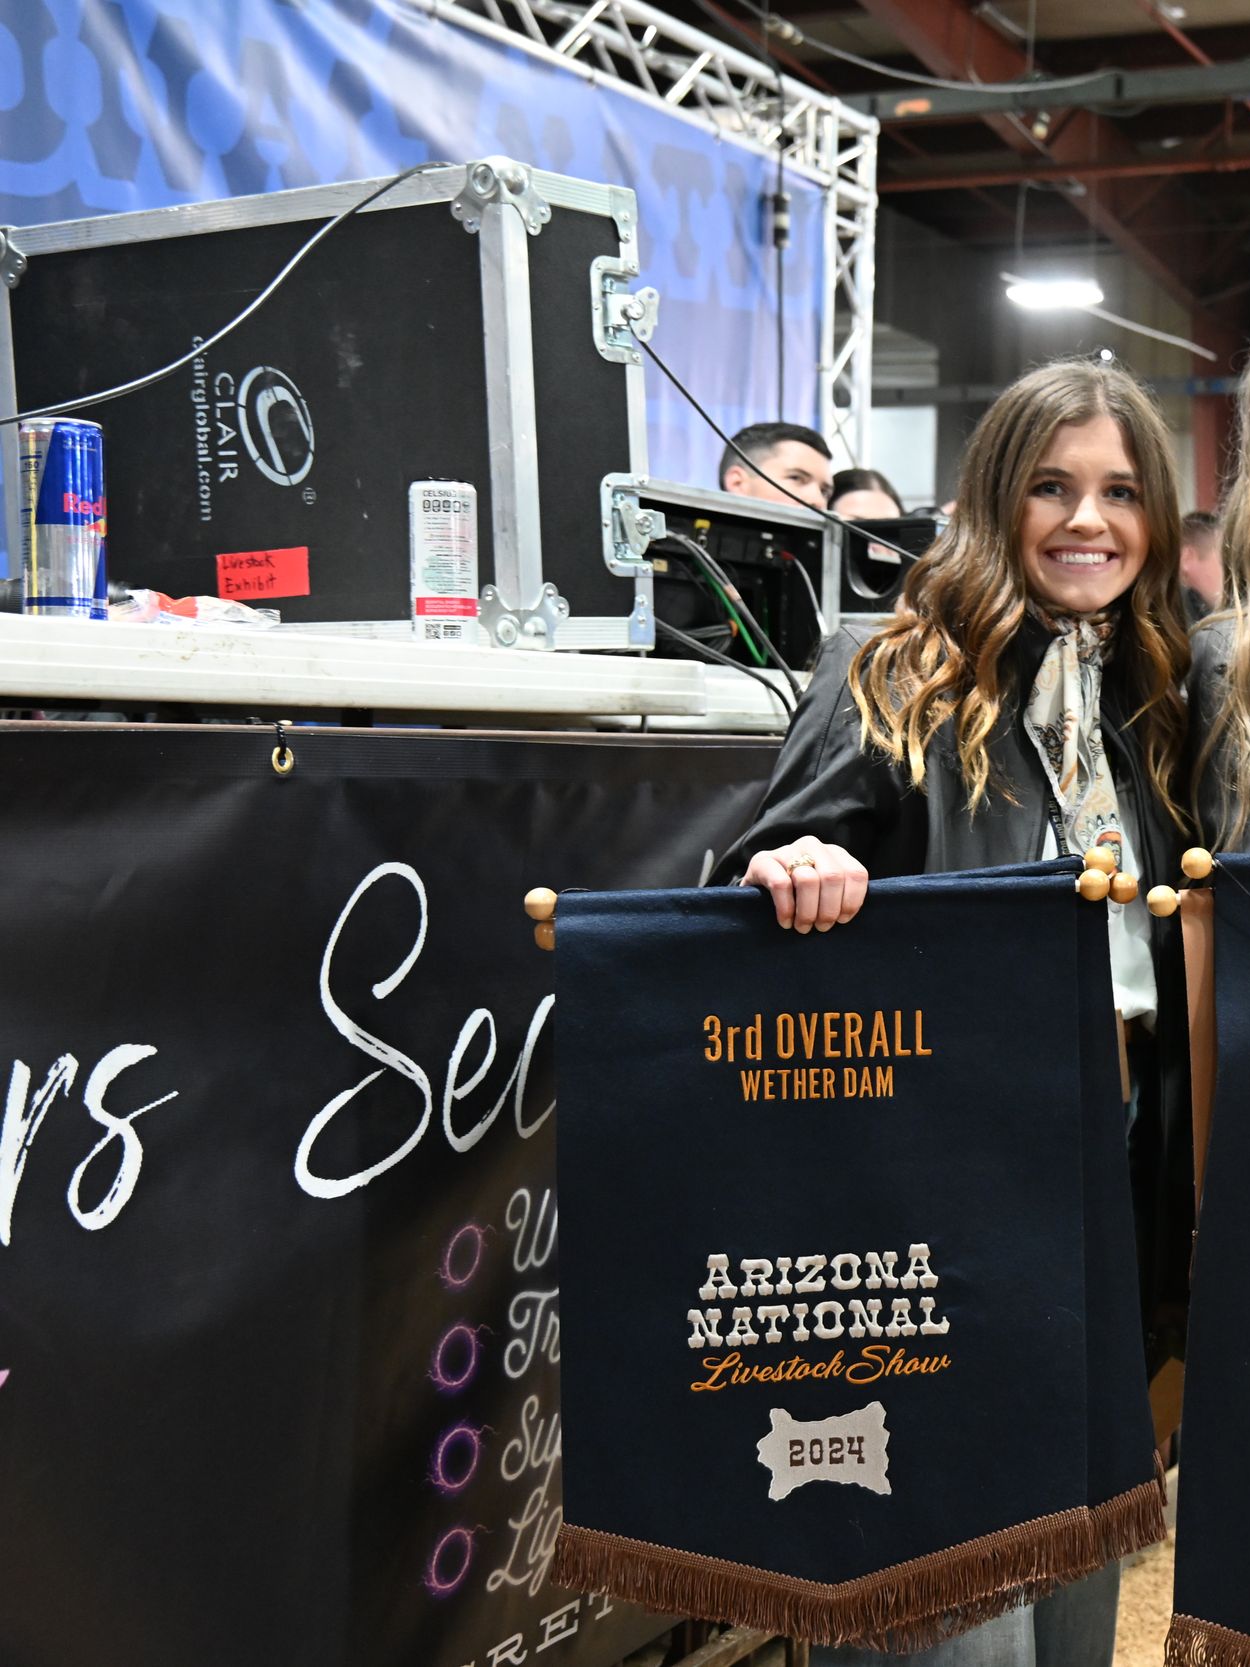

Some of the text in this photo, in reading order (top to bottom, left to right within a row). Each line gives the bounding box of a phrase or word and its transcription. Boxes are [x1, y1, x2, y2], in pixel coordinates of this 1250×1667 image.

[190, 336, 212, 521] cairglobal.com
[214, 372, 239, 483] CLAIR
[221, 554, 276, 570] Livestock
[225, 576, 277, 594] Exhibit
[703, 1009, 933, 1062] 3rd OVERALL
[740, 1065, 893, 1101] WETHER DAM
[698, 1243, 939, 1300] ARIZONA
[687, 1296, 950, 1349] NATIONAL
[690, 1345, 951, 1392] Livestock Show
[789, 1435, 866, 1467] 2024
